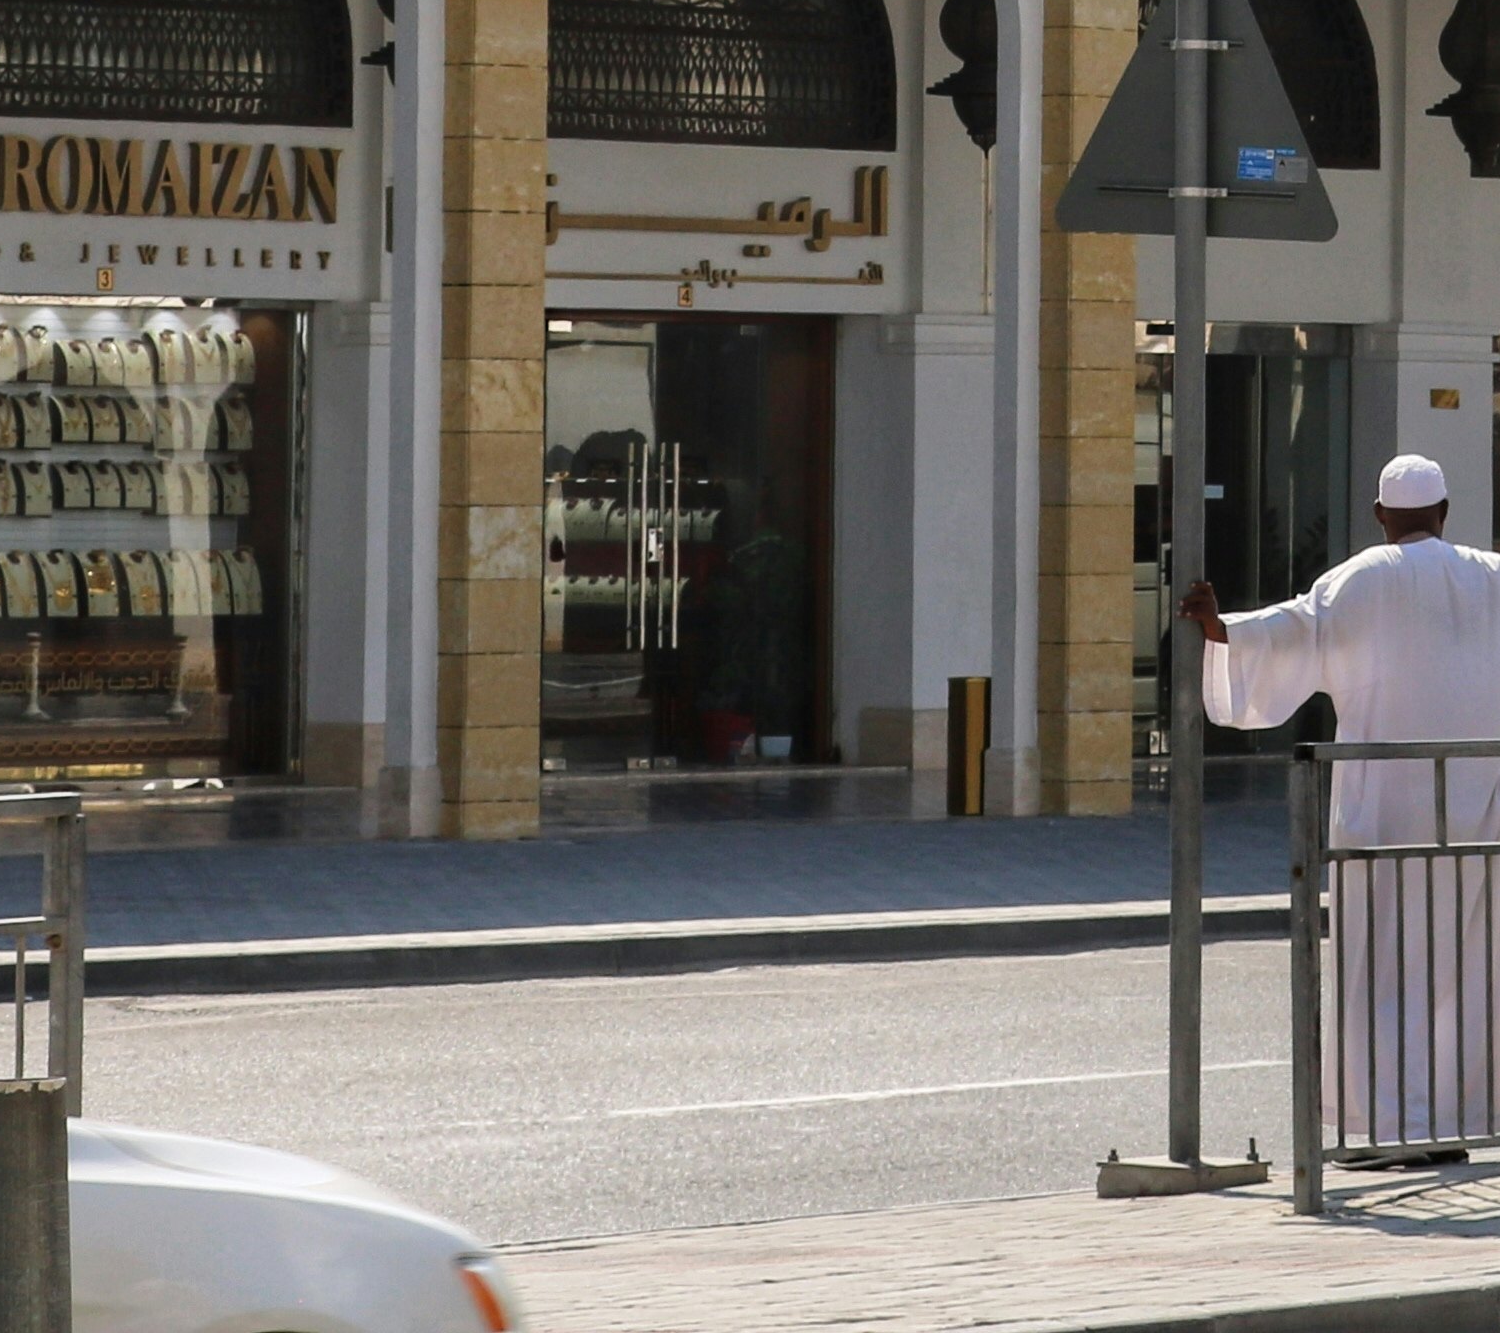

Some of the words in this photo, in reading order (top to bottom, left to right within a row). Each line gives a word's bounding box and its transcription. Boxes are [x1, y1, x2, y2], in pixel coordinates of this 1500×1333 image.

[78, 242, 332, 271] JEWELLERY
[100, 270, 112, 288] 3
[681, 289, 692, 304] 4
